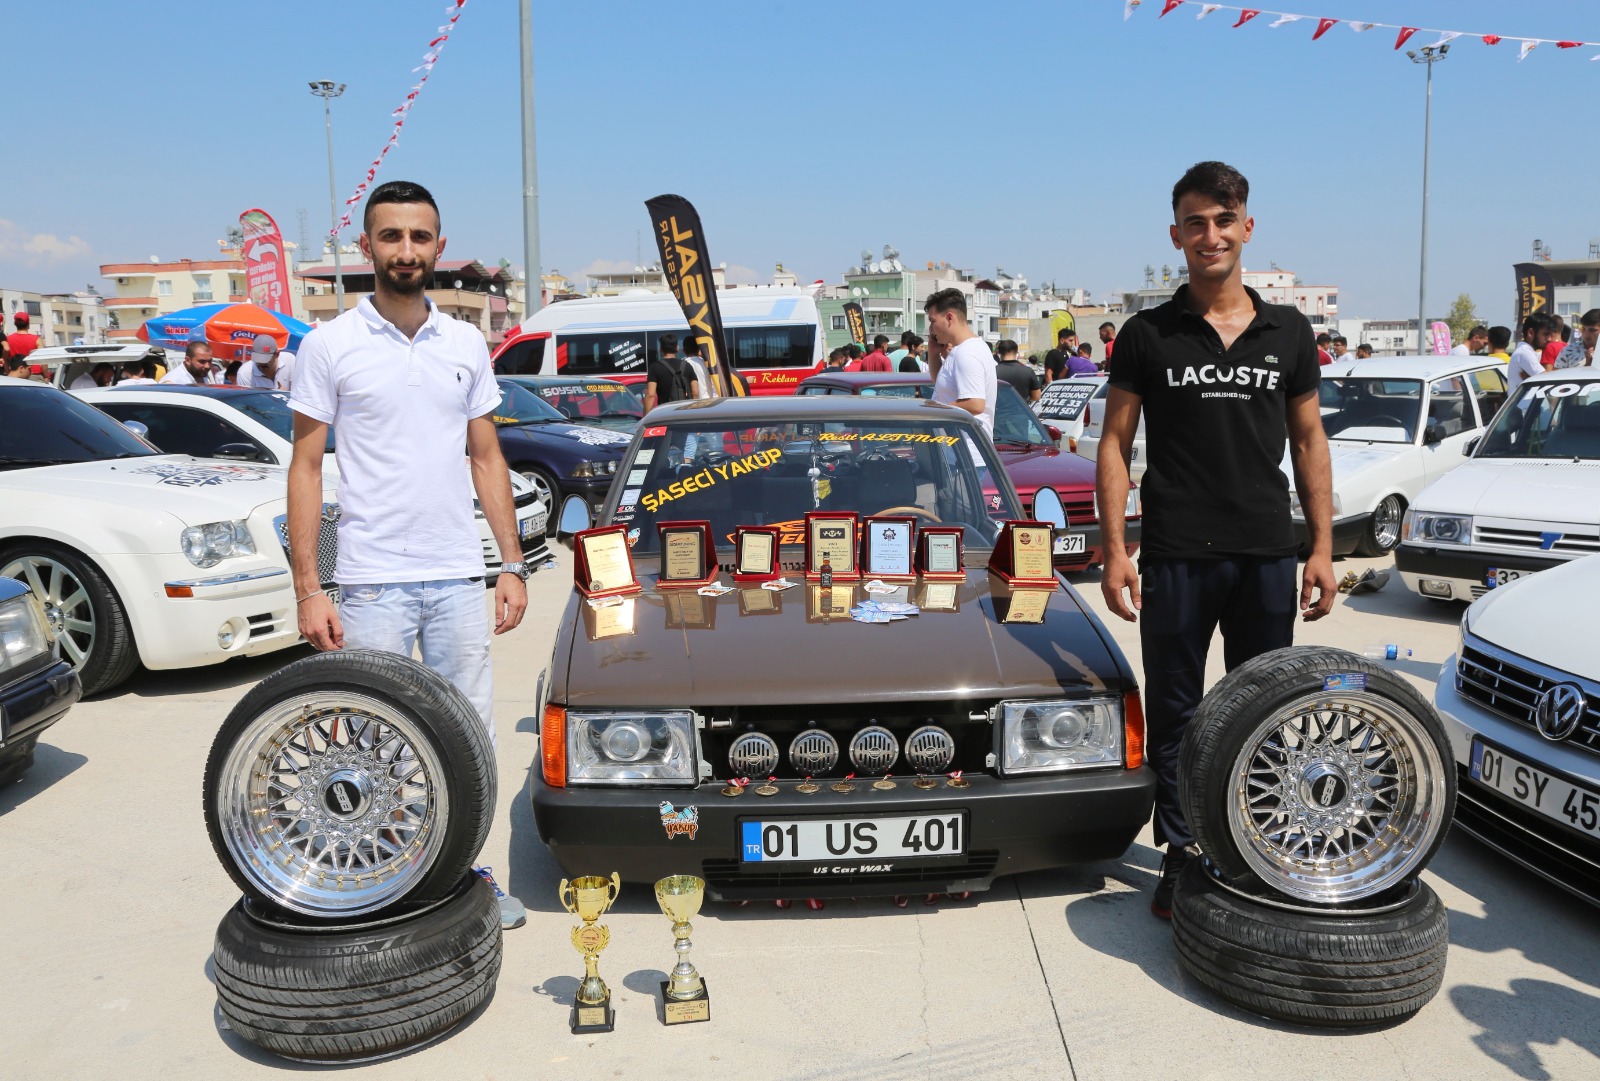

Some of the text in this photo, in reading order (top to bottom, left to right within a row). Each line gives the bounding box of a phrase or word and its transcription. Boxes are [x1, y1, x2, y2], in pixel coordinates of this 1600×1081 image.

[761, 372, 798, 383] Reklam
[1166, 364, 1280, 390] LACOSTE
[542, 385, 587, 398] SOYSAL
[641, 448, 782, 513] ŞASECİ YAKUP
[1062, 536, 1083, 551] 371
[1473, 761, 1481, 773] TR
[1481, 750, 1600, 831] 01 SY 45
[762, 817, 959, 858] 01 US 401
[746, 844, 761, 854] TR
[832, 866, 857, 874] Car
[859, 864, 894, 873] WAX
